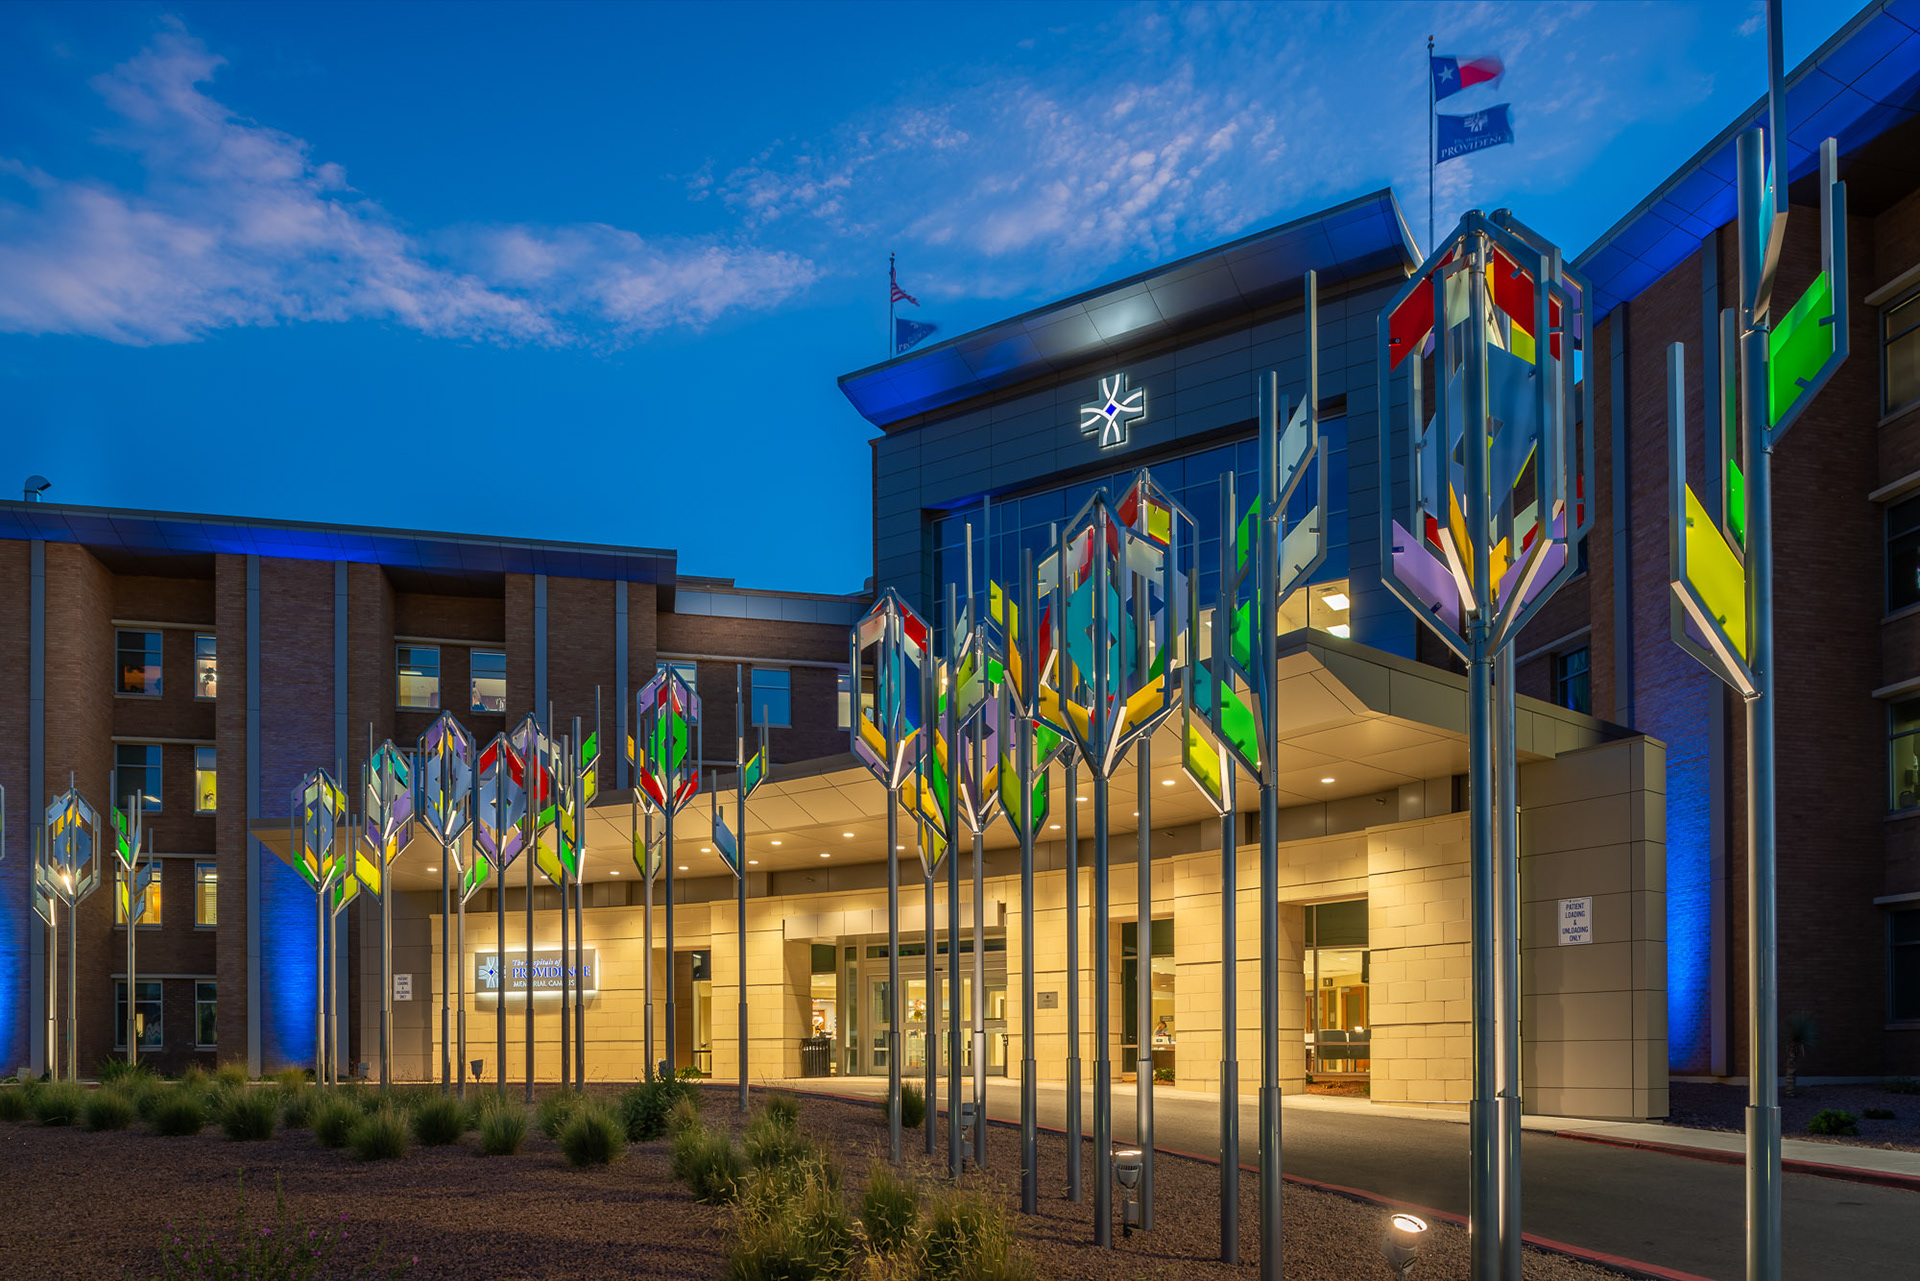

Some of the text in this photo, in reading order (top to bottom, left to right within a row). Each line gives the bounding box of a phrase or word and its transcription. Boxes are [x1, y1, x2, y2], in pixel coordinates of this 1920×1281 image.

[1441, 133, 1511, 158] PROVIDENC
[1565, 902, 1585, 910] PATIENT
[1565, 910, 1585, 918] LOADING
[1562, 926, 1588, 934] UNLOADING
[525, 958, 553, 968] spitals
[554, 958, 562, 967] of
[512, 966, 591, 979] PRVIDENE
[513, 979, 575, 988] MERIAL CAMS
